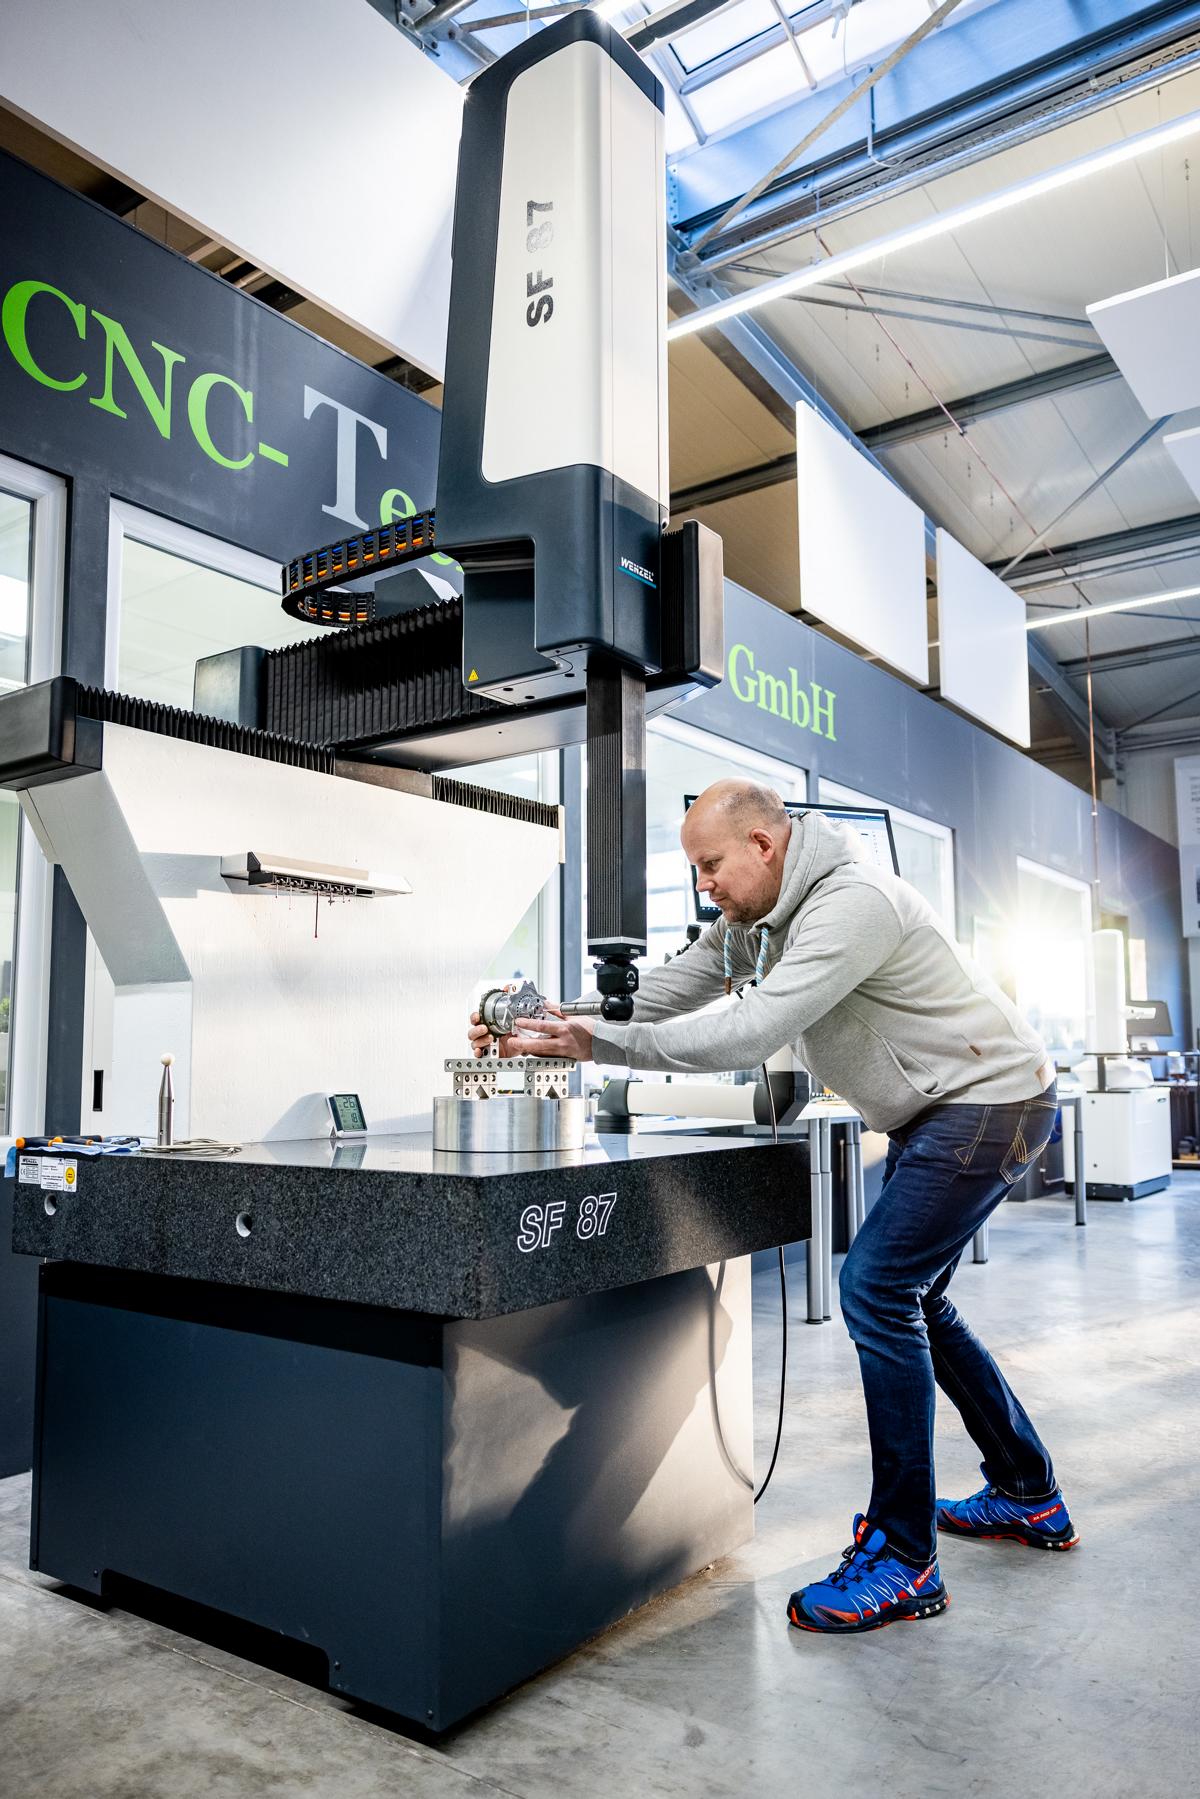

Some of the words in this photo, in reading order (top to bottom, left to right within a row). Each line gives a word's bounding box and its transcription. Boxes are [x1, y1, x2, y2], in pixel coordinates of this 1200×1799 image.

[526, 200, 553, 253] 87
[526, 269, 553, 327] SF
[2, 280, 464, 572] CNC-Te
[728, 644, 837, 742] GmbH
[620, 556, 654, 582] WENZEL
[517, 1201, 566, 1253] SF
[577, 1192, 617, 1240] 87
